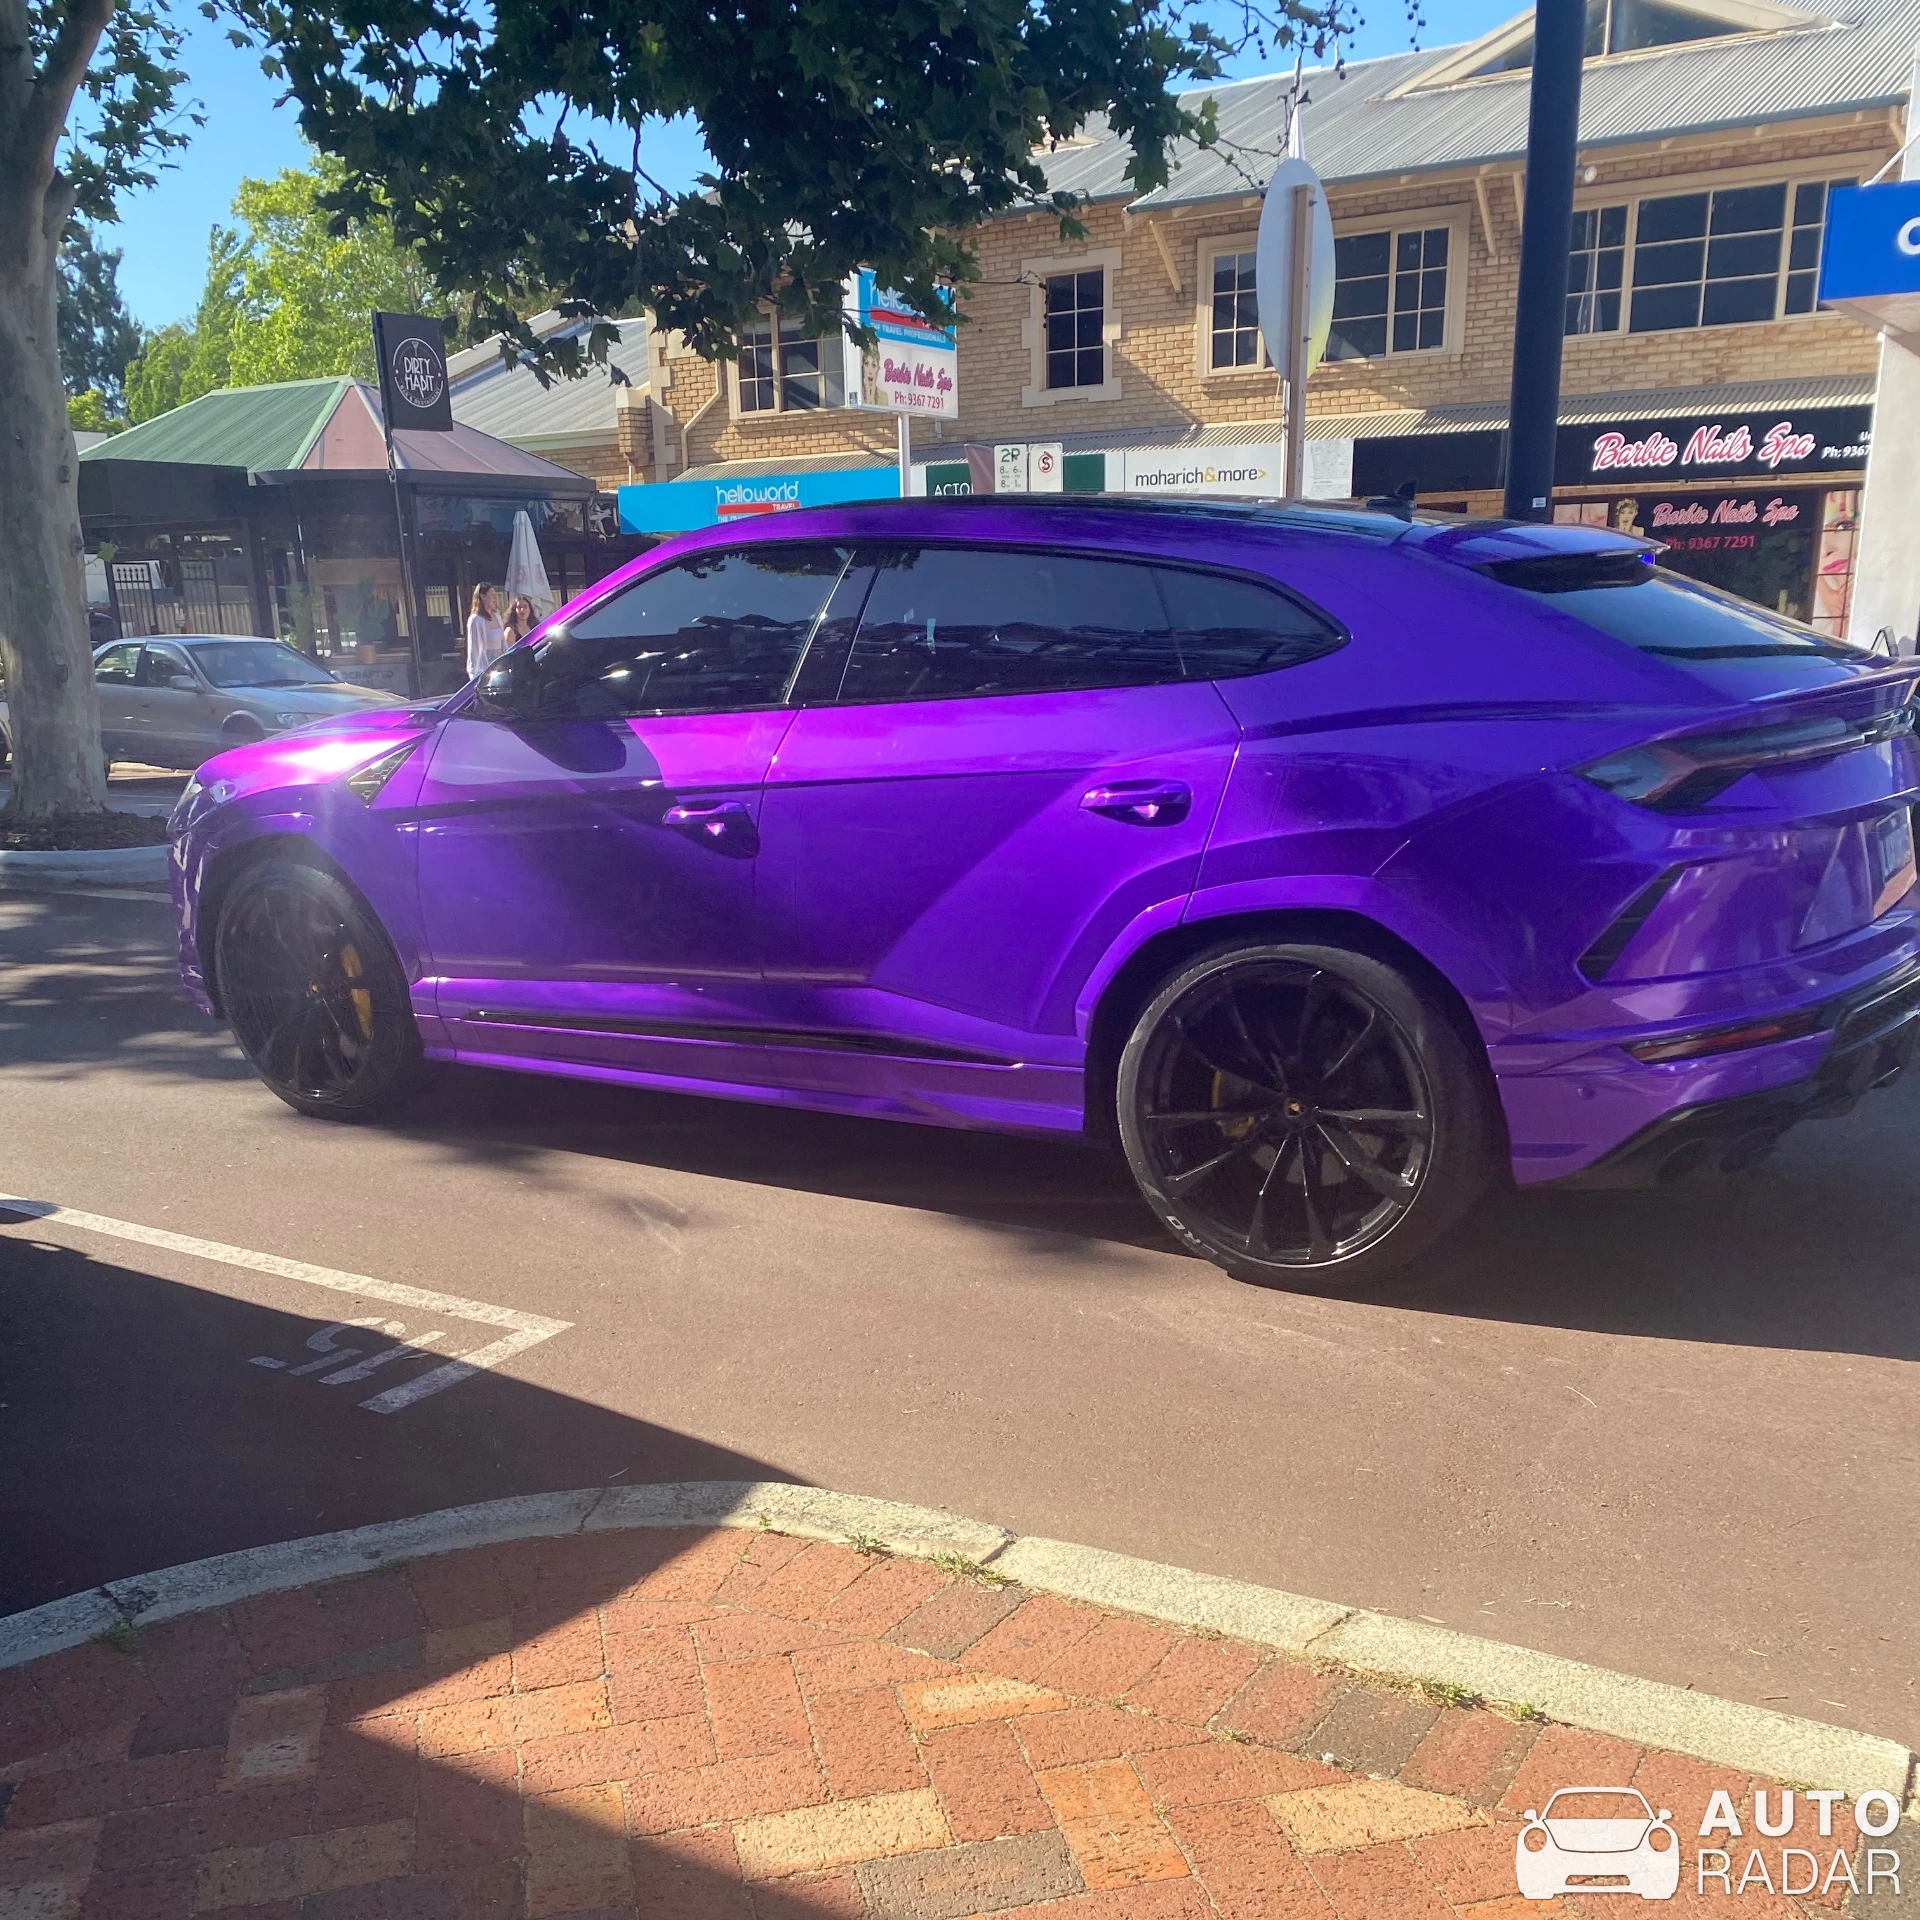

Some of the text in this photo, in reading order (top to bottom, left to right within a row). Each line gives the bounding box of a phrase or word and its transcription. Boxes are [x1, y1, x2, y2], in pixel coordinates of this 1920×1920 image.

[882, 324, 903, 336] TRAVEL
[904, 328, 947, 344] PROFESSIONALS
[403, 356, 431, 375] DIRTY
[404, 374, 435, 397] HABIT
[884, 358, 953, 395] Barbie Nails Spa
[894, 391, 944, 409] Ph: 9367 7291
[1592, 421, 1816, 472] Barbie Nails Spa
[1842, 444, 1871, 458] 9367
[715, 481, 799, 504] helloworld
[934, 482, 974, 496] ACTO
[1652, 498, 1799, 527] Barbie Nails Spa
[1688, 536, 1720, 550] 9367
[1723, 535, 1755, 548] 7291
